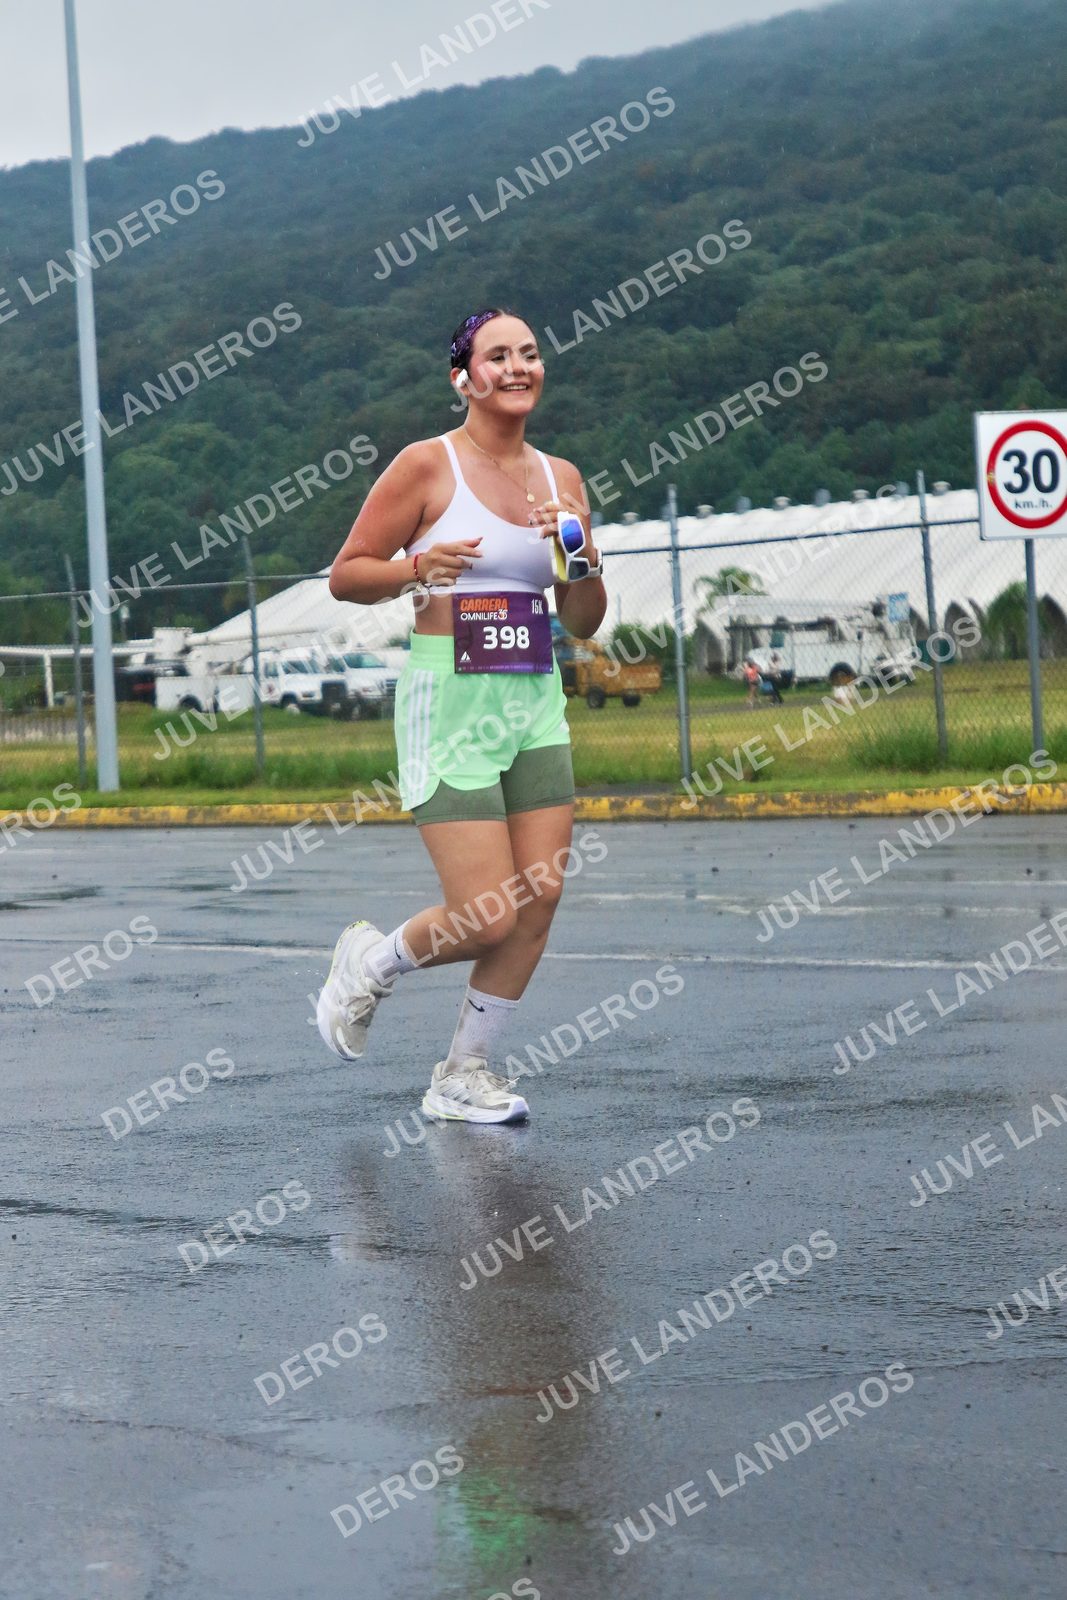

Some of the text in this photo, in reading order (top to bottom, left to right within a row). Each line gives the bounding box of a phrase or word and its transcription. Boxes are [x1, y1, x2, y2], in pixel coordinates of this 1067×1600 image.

[1003, 448, 1060, 494] 30
[460, 598, 508, 612] CARRERA
[531, 599, 543, 614] 15K
[460, 611, 498, 621] OMNILIFE
[483, 626, 530, 650] 398
